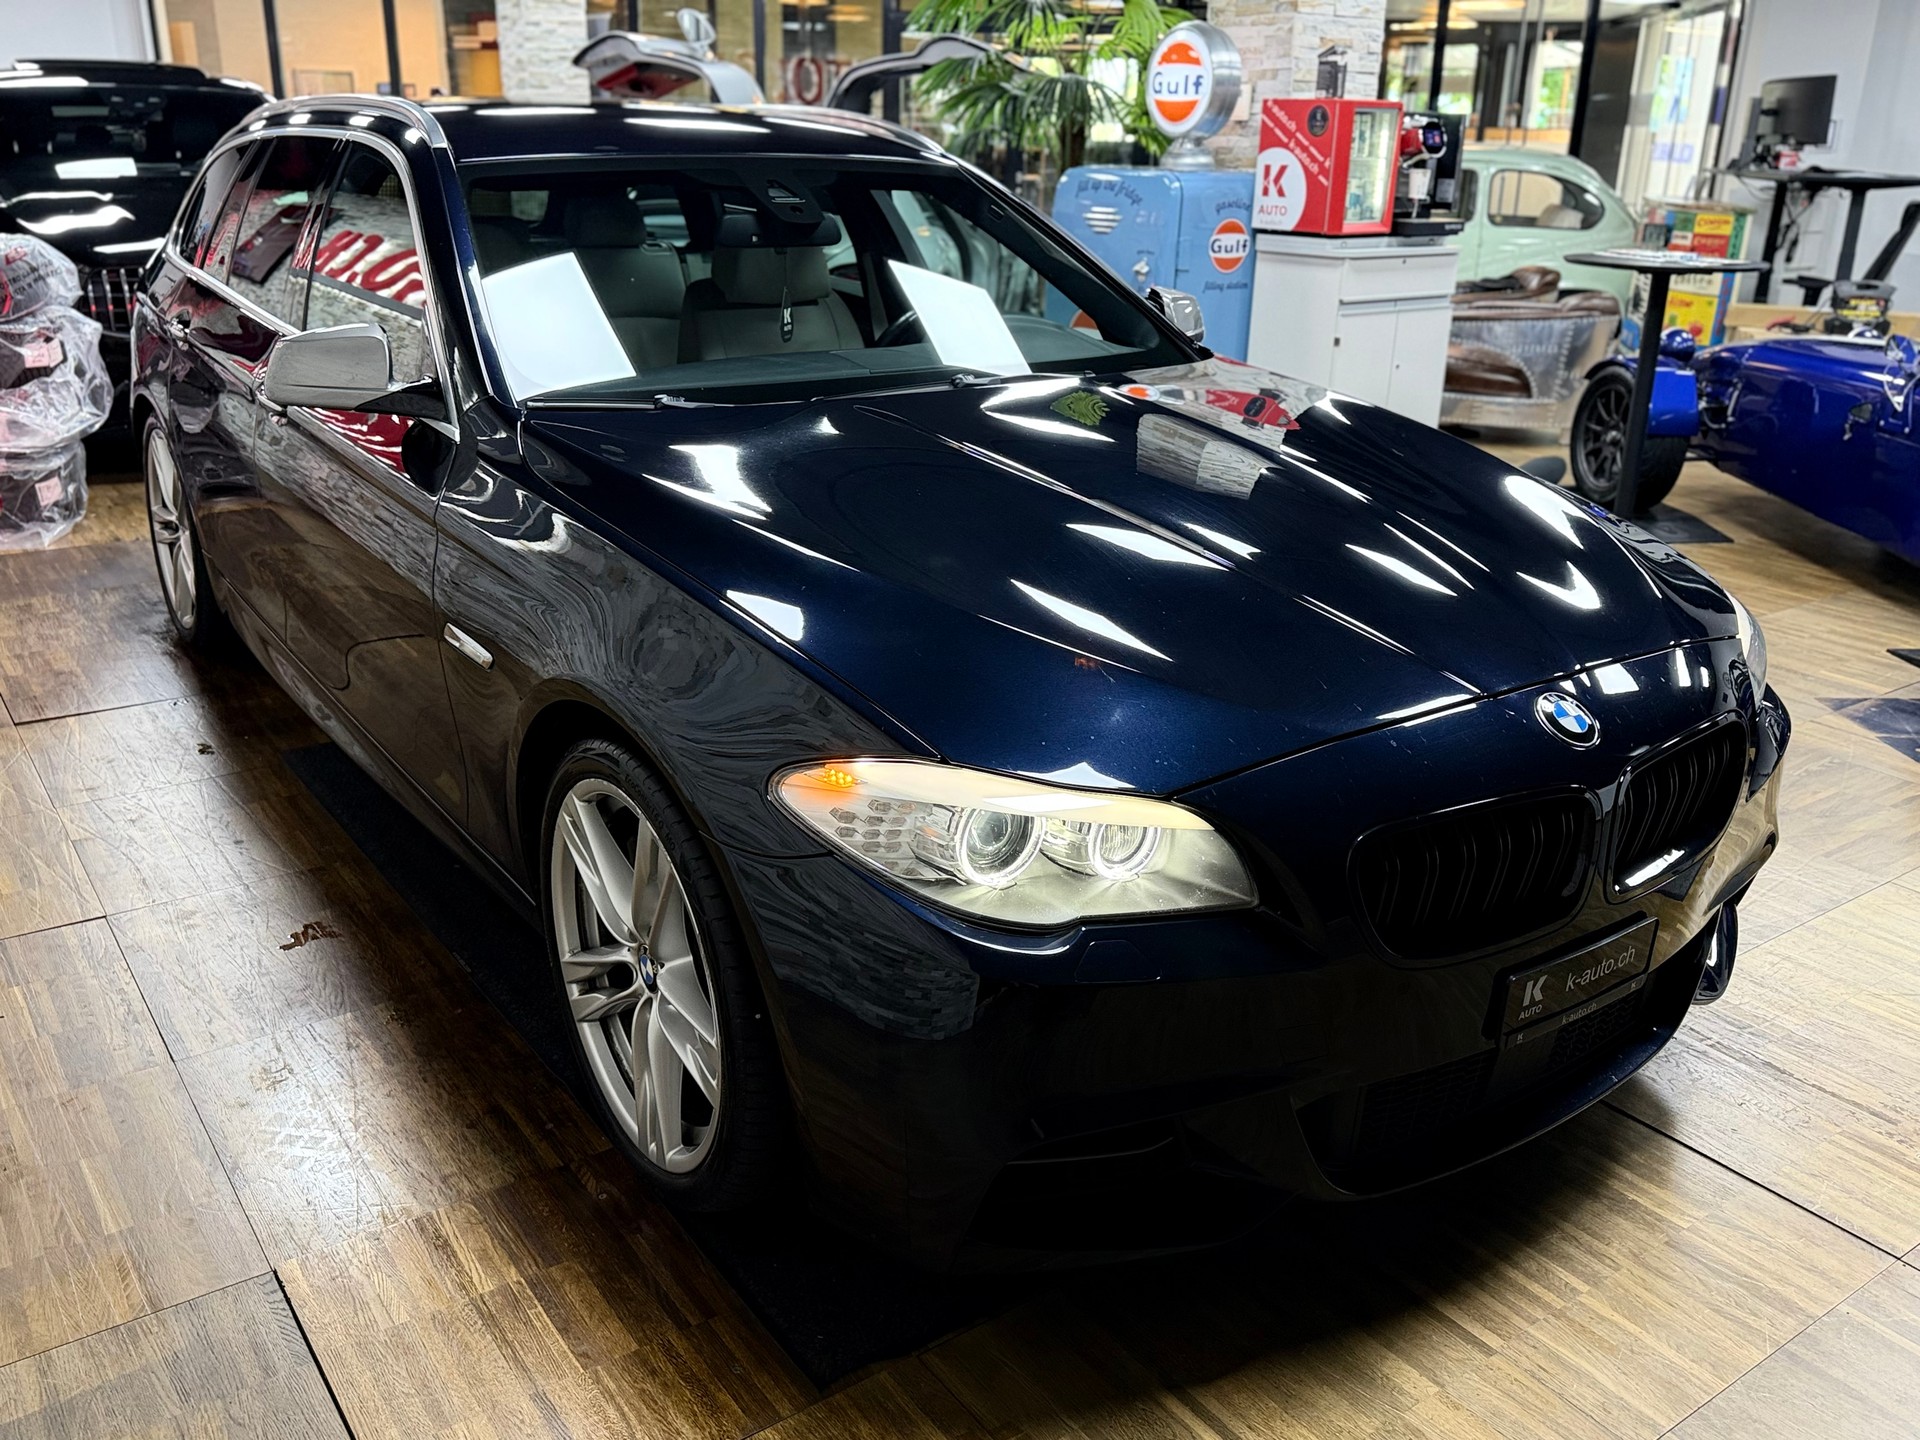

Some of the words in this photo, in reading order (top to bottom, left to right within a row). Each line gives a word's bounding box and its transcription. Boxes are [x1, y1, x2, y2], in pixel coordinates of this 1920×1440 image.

[1152, 71, 1204, 95] Gulf
[1262, 164, 1288, 198] K
[1258, 204, 1288, 217] AUTO
[1210, 238, 1249, 254] Gulf
[783, 307, 792, 324] K
[1522, 974, 1548, 1007] K
[1565, 945, 1636, 992] k-auto.ch
[1518, 1004, 1543, 1021] AUTO
[1561, 1002, 1597, 1025] k-auto.ch
